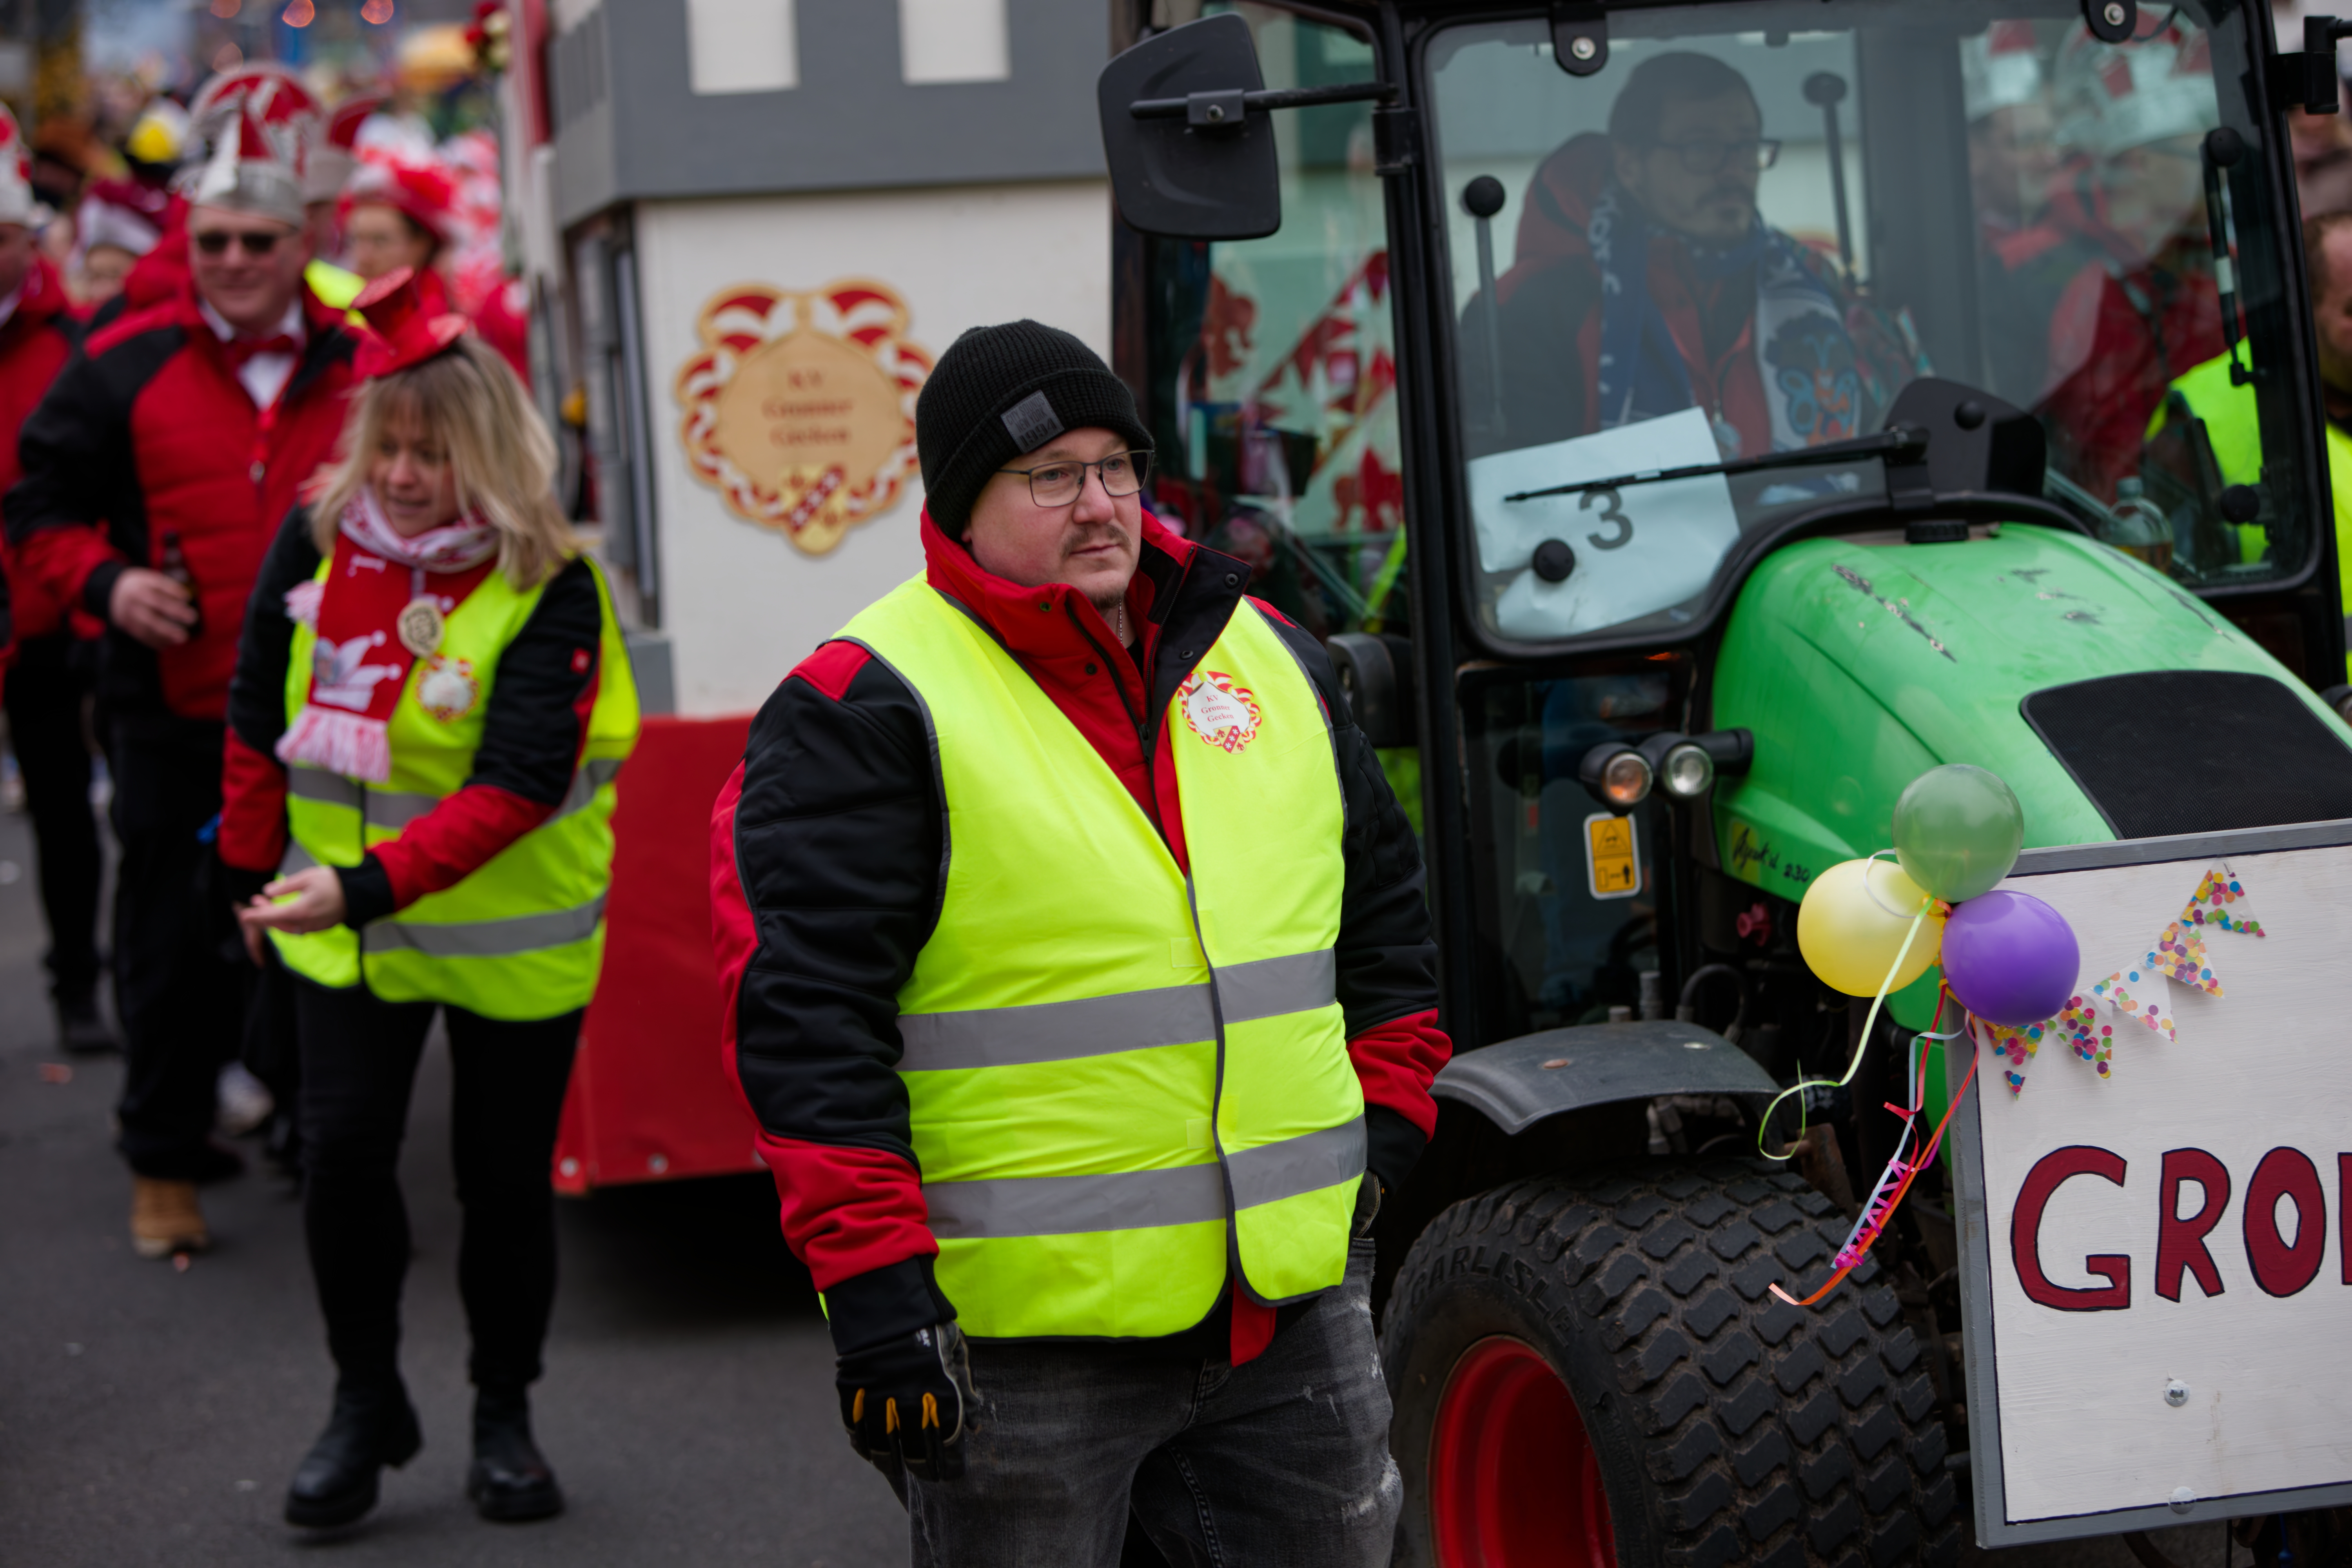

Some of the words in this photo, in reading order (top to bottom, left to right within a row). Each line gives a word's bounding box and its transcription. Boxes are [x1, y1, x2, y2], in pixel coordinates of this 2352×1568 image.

[1005, 409, 1020, 426] CITY
[1019, 395, 1045, 416] SOUNDS
[1015, 417, 1031, 433] NEW
[1028, 407, 1047, 424] YORK
[1018, 418, 1057, 447] 1994
[1578, 488, 1634, 551] 3
[1201, 705, 1230, 714] Gronner
[1208, 713, 1234, 722] Gecken
[1783, 863, 1811, 883] 230
[2011, 1145, 2352, 1312] GRO
[1409, 1245, 1584, 1348] CARLISLE
